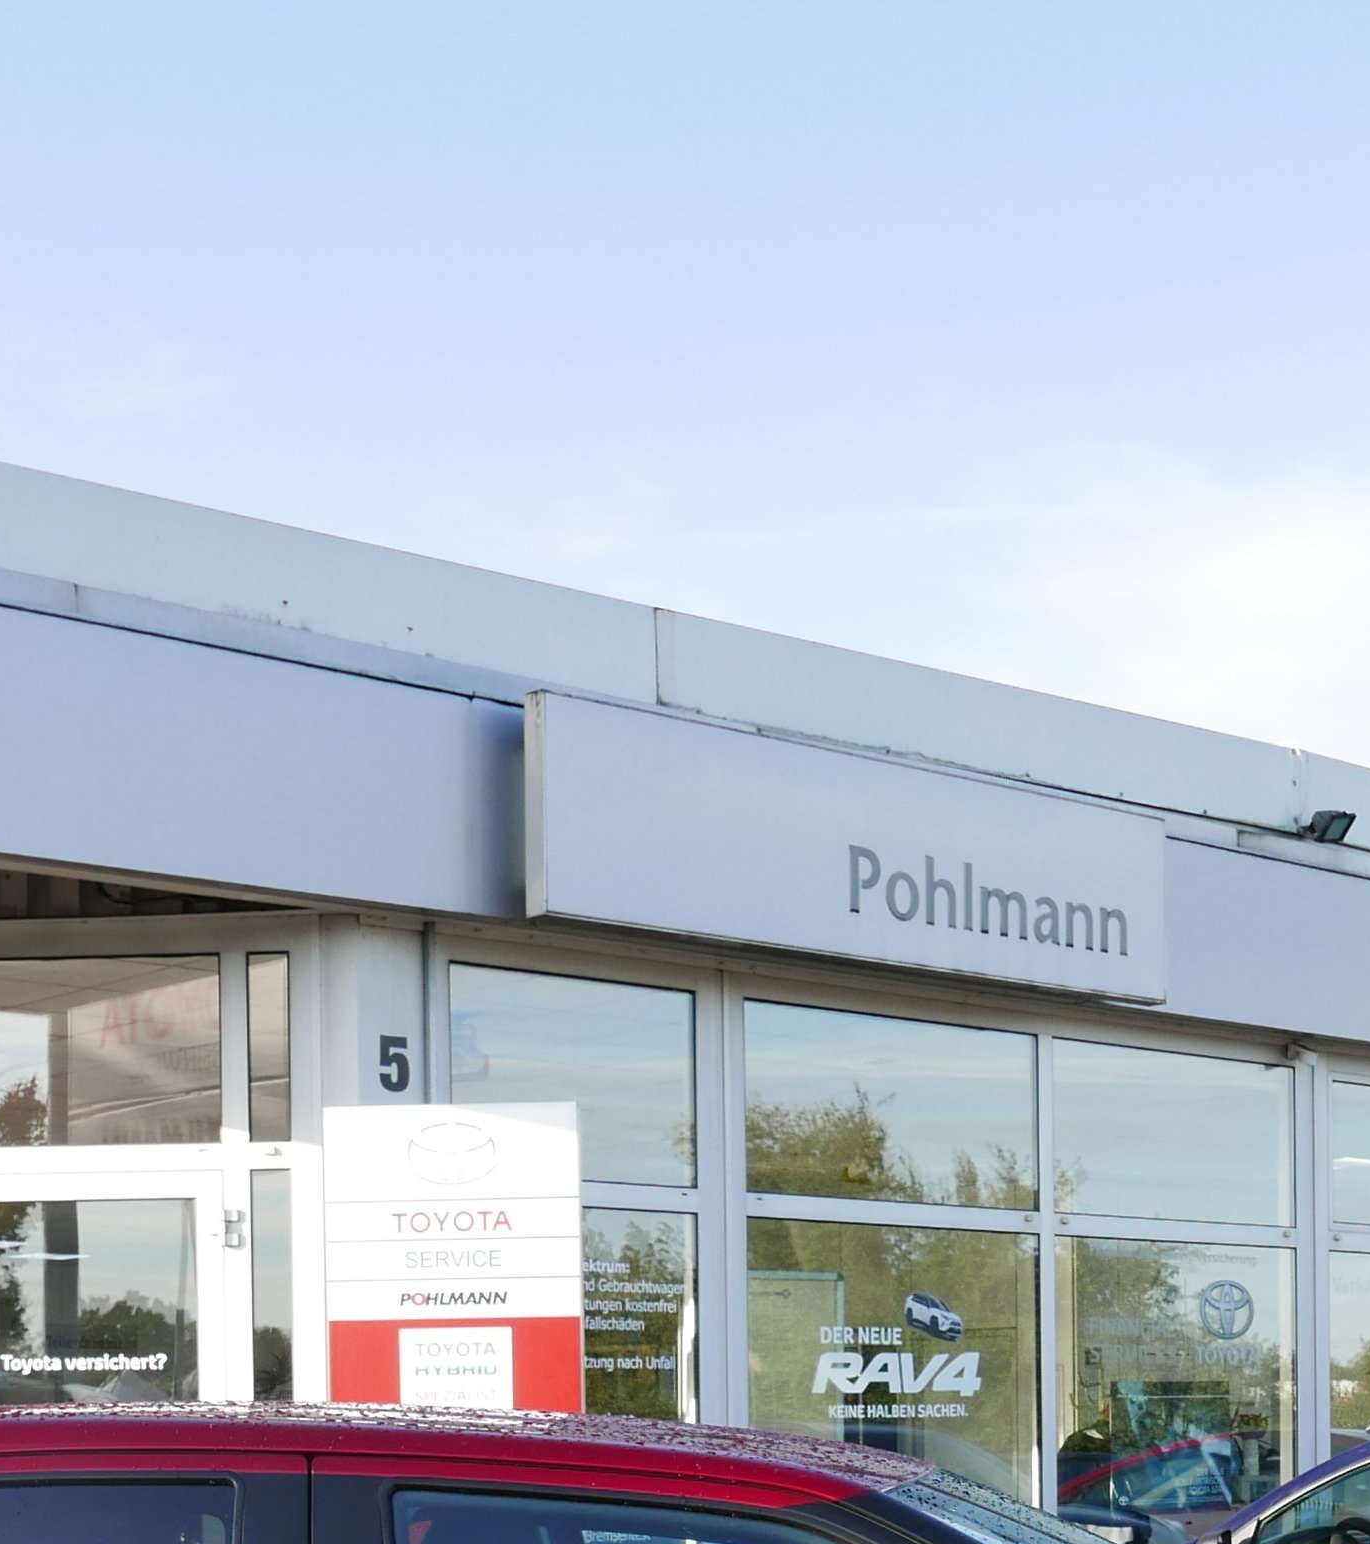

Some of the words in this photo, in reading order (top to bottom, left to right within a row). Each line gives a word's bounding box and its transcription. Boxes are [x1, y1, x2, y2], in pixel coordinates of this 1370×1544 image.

[848, 843, 1129, 957] Pohlmann
[379, 1034, 410, 1092] 5
[391, 1210, 513, 1233] TOYOTA
[404, 1249, 502, 1269] SERVICE
[583, 1258, 630, 1273] ektrum:
[400, 1291, 507, 1306] POHLMANN
[585, 1300, 622, 1314] tungen
[625, 1301, 677, 1313] kostenfrei
[585, 1315, 645, 1331] fallschäden
[820, 1327, 854, 1345] DER
[858, 1327, 903, 1345] NEUE
[415, 1342, 497, 1358] TOYOTA
[0, 1354, 61, 1376] Toyota
[65, 1353, 169, 1371] versichert?
[585, 1356, 614, 1372] tzung
[617, 1357, 643, 1368] nach
[646, 1356, 676, 1370] Unfall
[811, 1352, 982, 1397] RAV4
[829, 1404, 865, 1418] KEINE
[867, 1404, 915, 1418] HALBEN
[917, 1403, 969, 1417] SACHEN.
